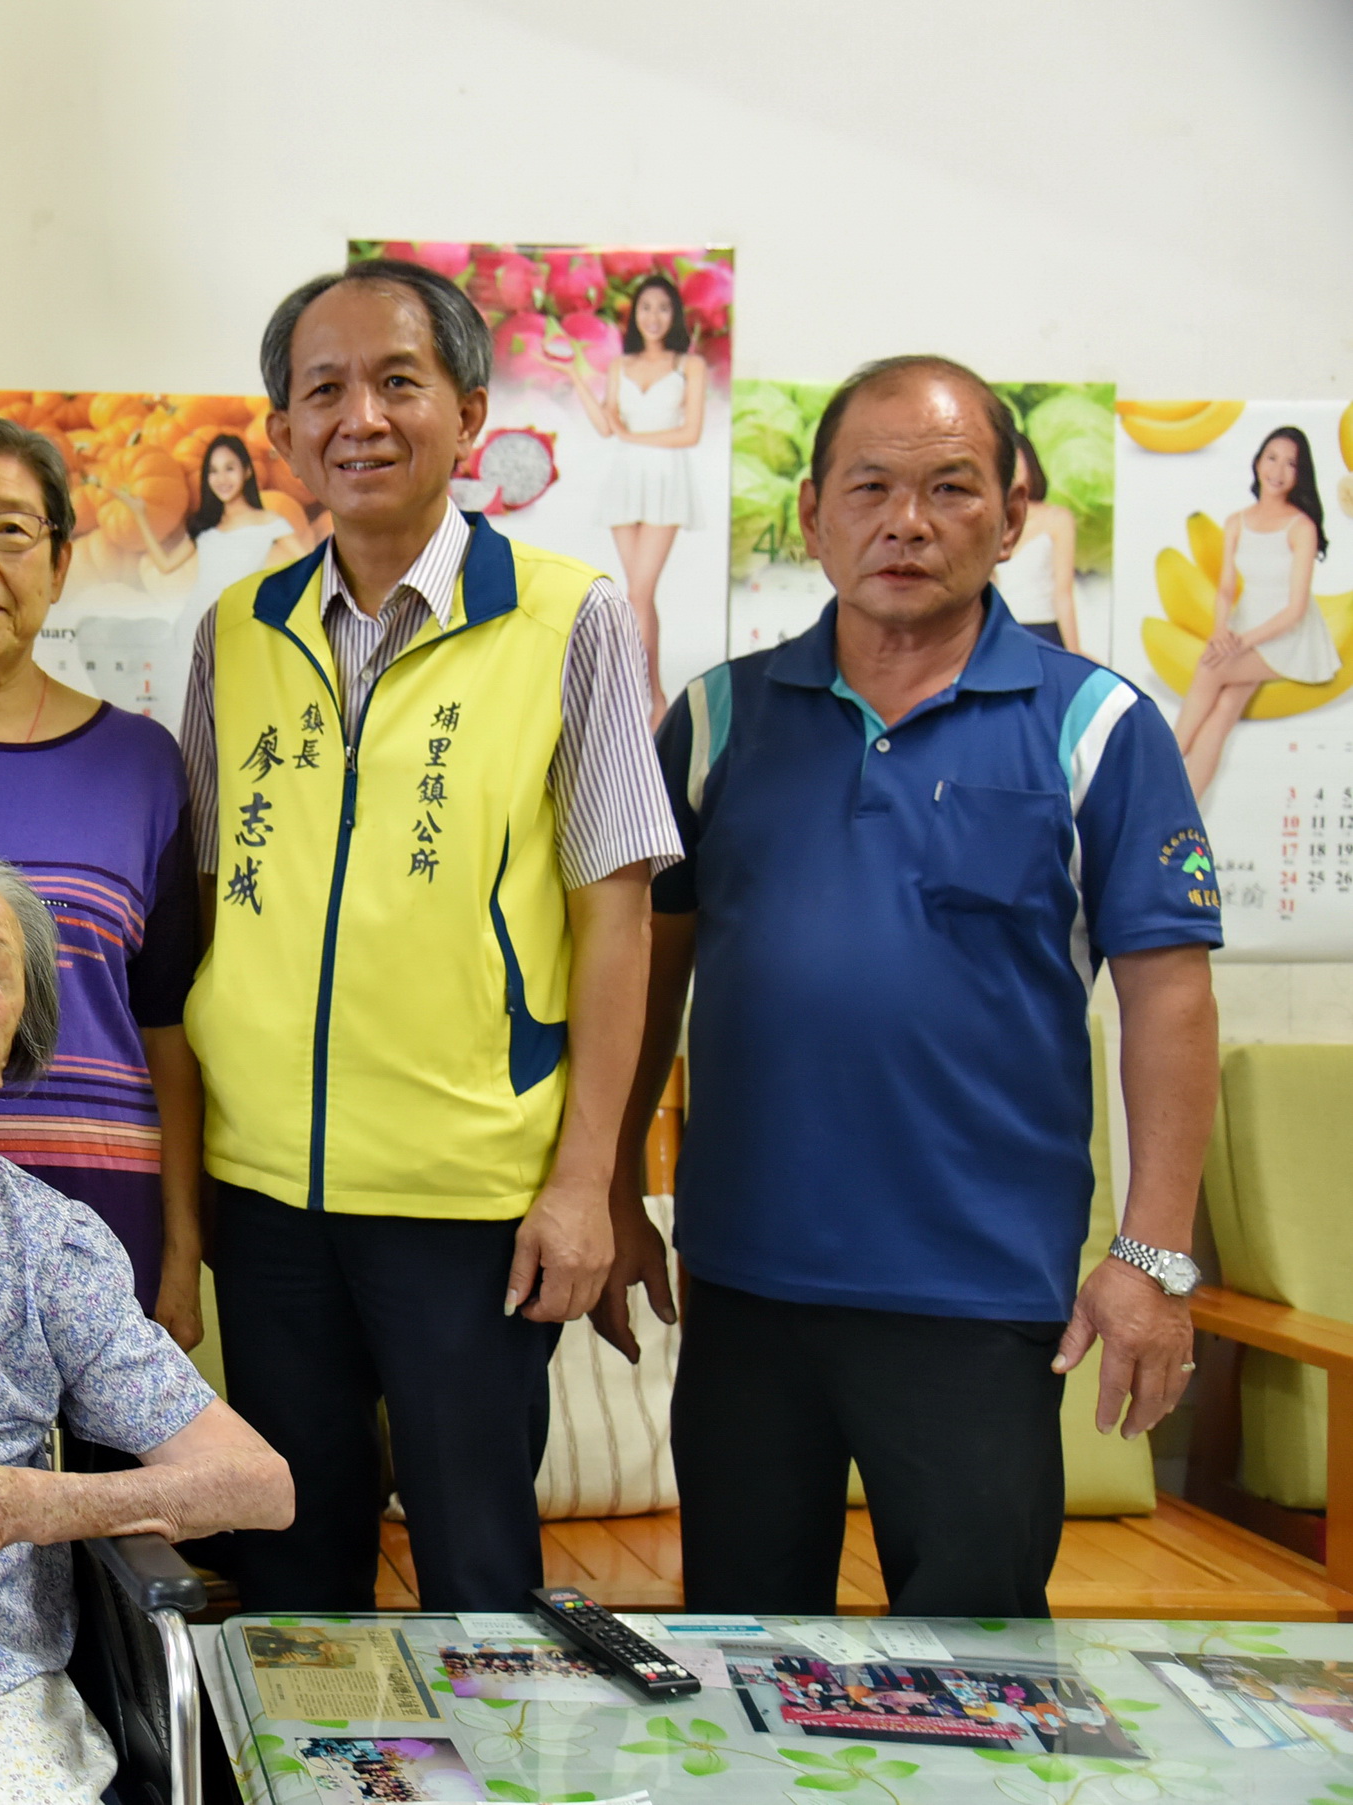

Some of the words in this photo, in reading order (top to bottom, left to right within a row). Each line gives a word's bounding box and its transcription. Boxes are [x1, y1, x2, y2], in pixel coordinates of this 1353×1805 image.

[752, 523, 778, 563] 4
[292, 702, 325, 770] 鎮長
[407, 702, 461, 884] 埔里鎮公所
[224, 726, 284, 915] 廖志城
[1283, 816, 1300, 829] 10
[1311, 816, 1325, 829] 11
[1339, 816, 1353, 829] 12
[1281, 843, 1298, 857] 17
[1308, 844, 1326, 857] 18
[1337, 843, 1353, 857] 19
[1280, 871, 1297, 885] 24
[1308, 871, 1325, 885] 25
[1335, 871, 1353, 885] 26
